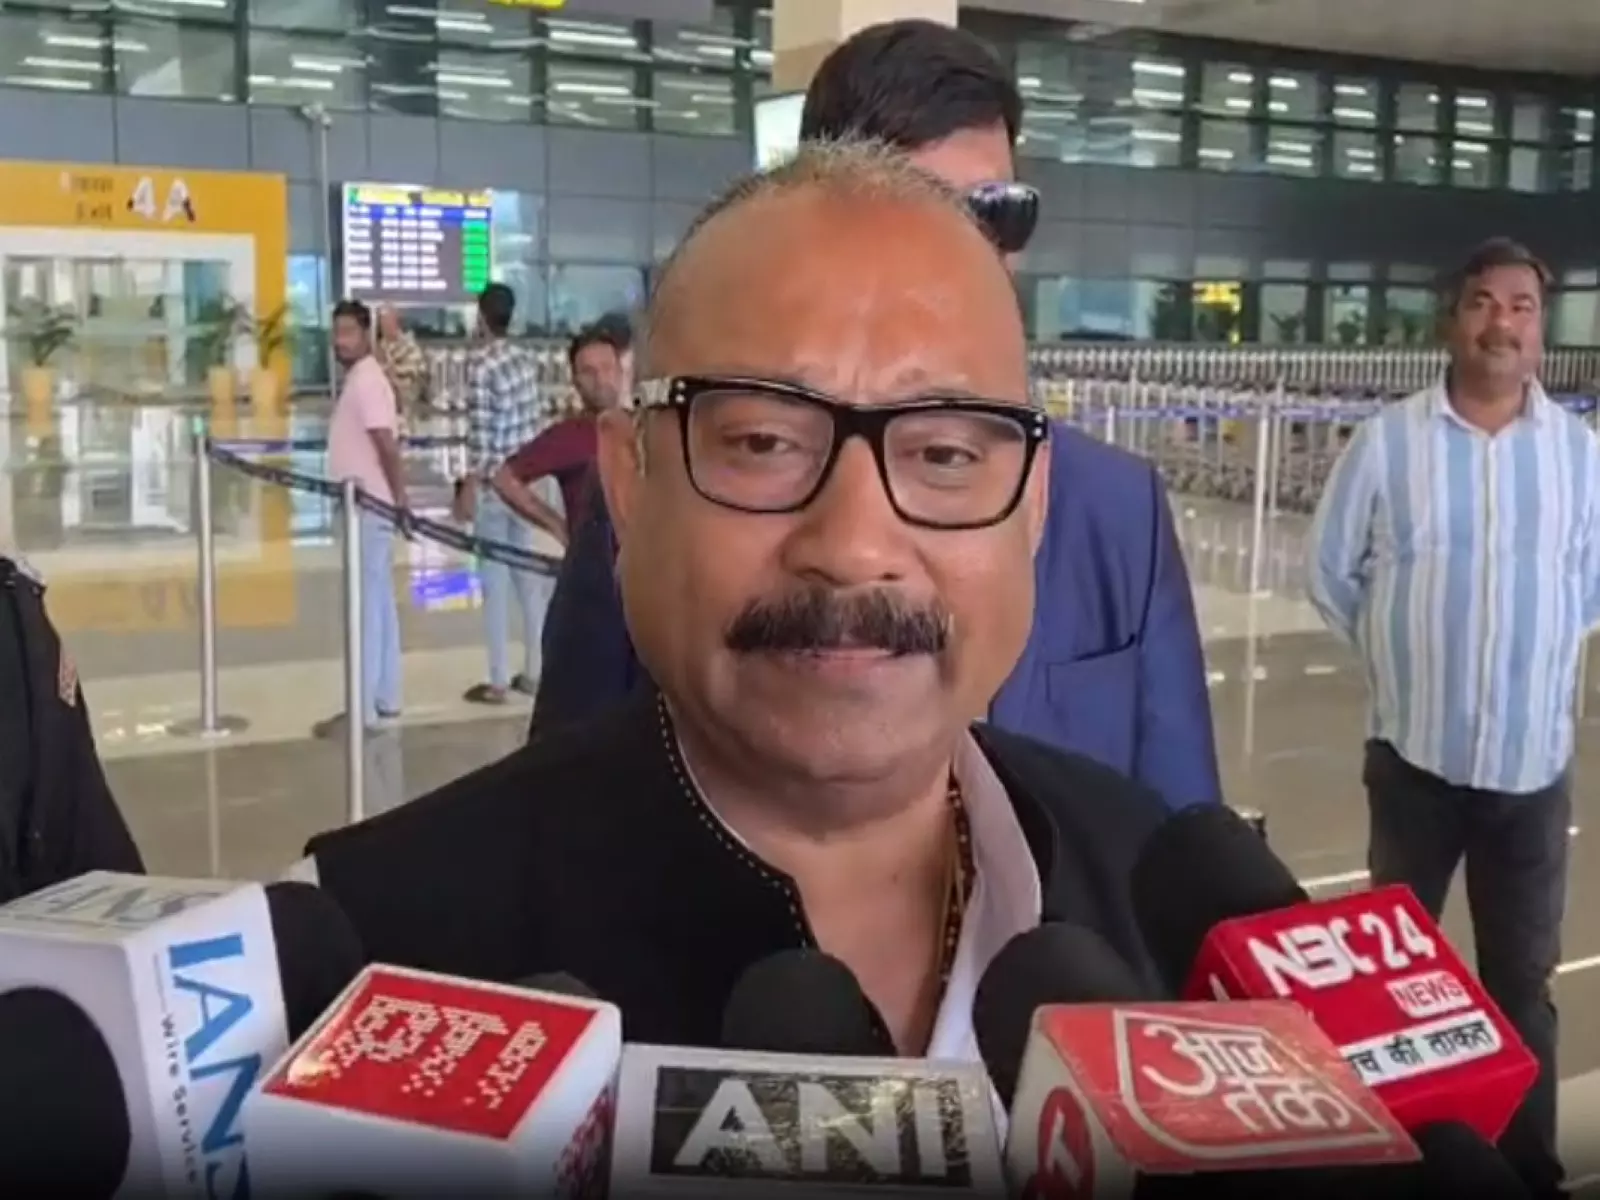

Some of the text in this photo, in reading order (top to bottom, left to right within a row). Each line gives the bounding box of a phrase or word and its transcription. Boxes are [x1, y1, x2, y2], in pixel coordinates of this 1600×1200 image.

[1359, 904, 1437, 969] 24
[1395, 974, 1464, 1007] NEWS
[1141, 1023, 1284, 1096] आज
[1422, 1020, 1493, 1057] ताकत
[161, 1013, 197, 1184] Wire Service
[673, 1078, 948, 1177] ANI
[1223, 1073, 1352, 1133] तक
